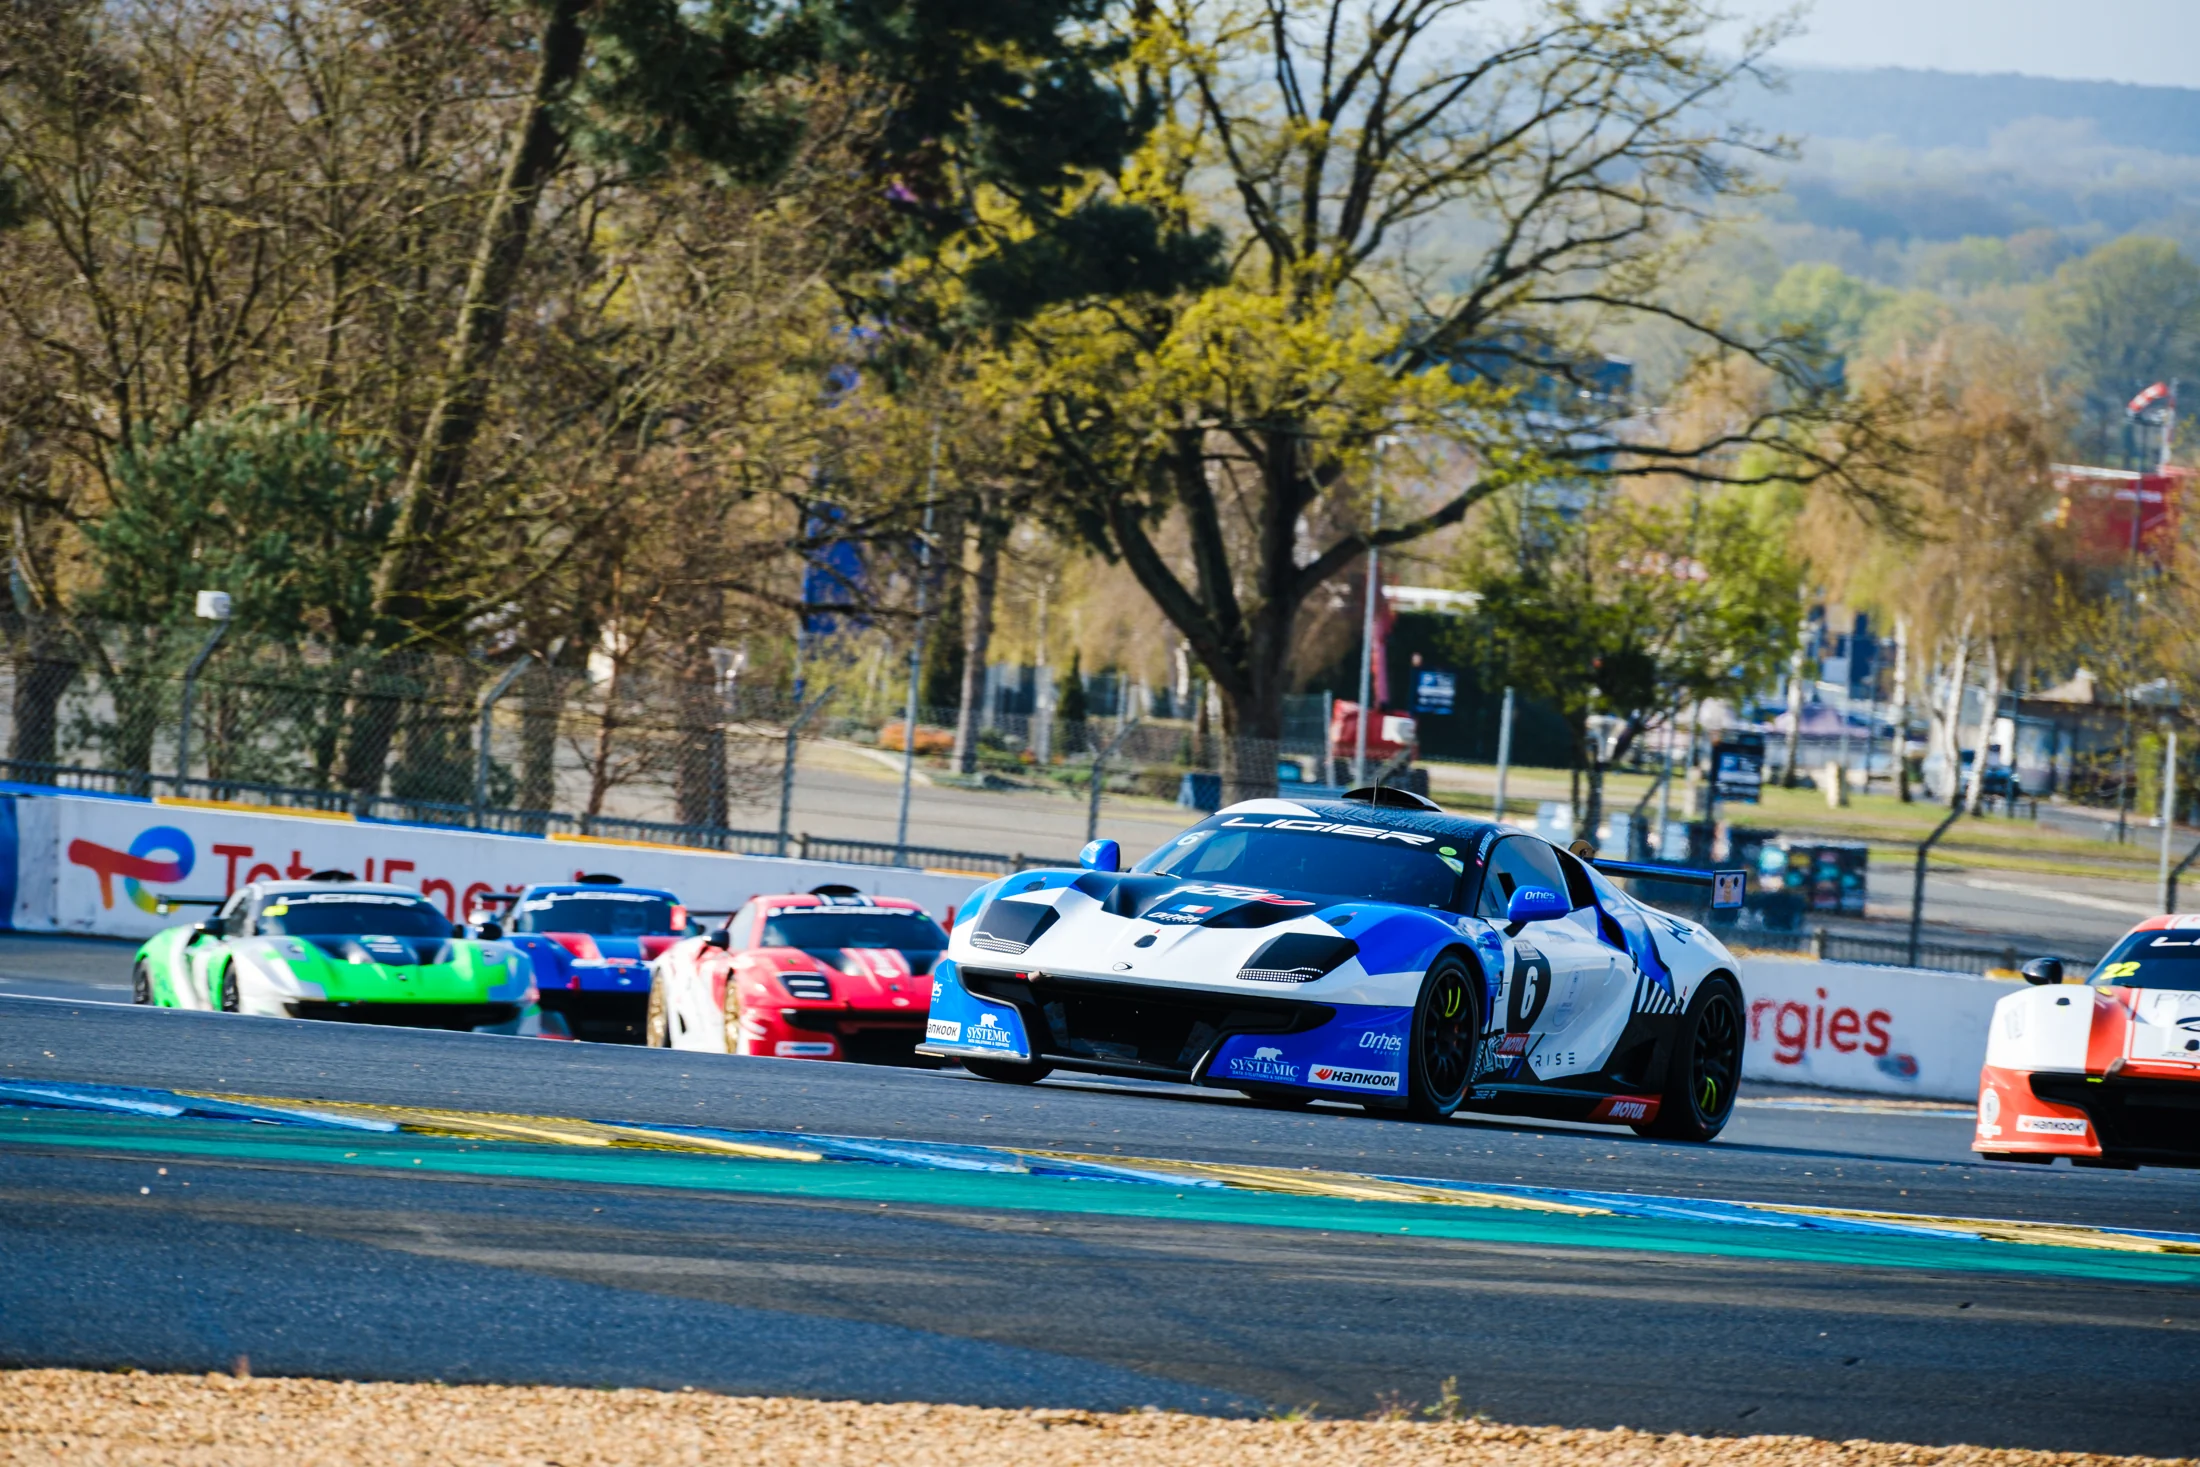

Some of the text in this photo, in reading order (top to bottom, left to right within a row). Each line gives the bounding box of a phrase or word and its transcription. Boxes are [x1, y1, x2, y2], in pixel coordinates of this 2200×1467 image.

[1176, 832, 1205, 846] 6
[1220, 816, 1436, 846] LIGIER
[2099, 961, 2142, 980] 22
[1519, 965, 1539, 1020] 6
[966, 1026, 1011, 1043] SYSTEMIC
[1750, 986, 1893, 1065] rgies
[1229, 1058, 1300, 1078] SYSTEMIC
[1534, 1052, 1576, 1067] RISE
[1607, 1100, 1647, 1120] MOTUL
